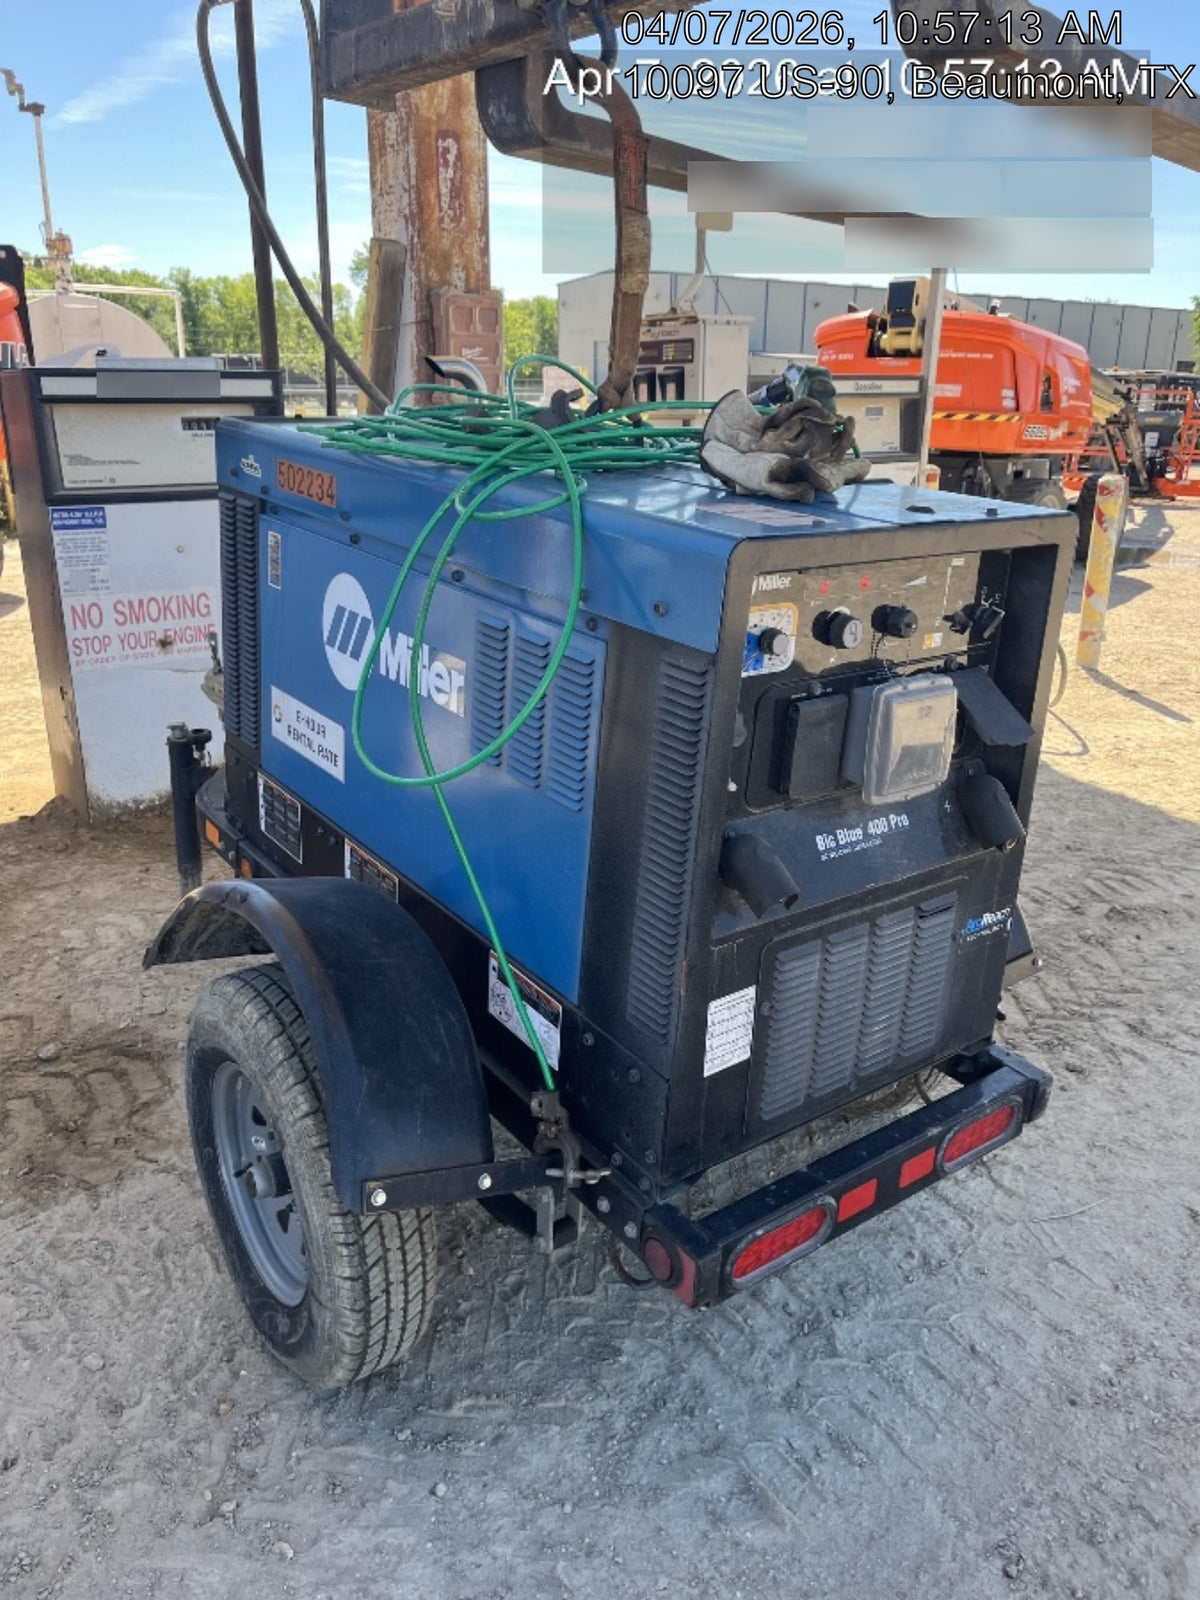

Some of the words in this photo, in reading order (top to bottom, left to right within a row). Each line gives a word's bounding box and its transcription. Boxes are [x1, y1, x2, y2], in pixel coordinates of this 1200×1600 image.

[278, 461, 335, 502] 502234
[757, 574, 793, 591] Miller
[70, 602, 104, 631] NO
[113, 592, 212, 627] SMOKING
[72, 635, 112, 657] STOP
[117, 630, 158, 651] YOUR
[379, 627, 465, 718] Miler
[836, 827, 863, 845] Blue
[867, 817, 889, 836] 400
[888, 813, 910, 830] Pro
